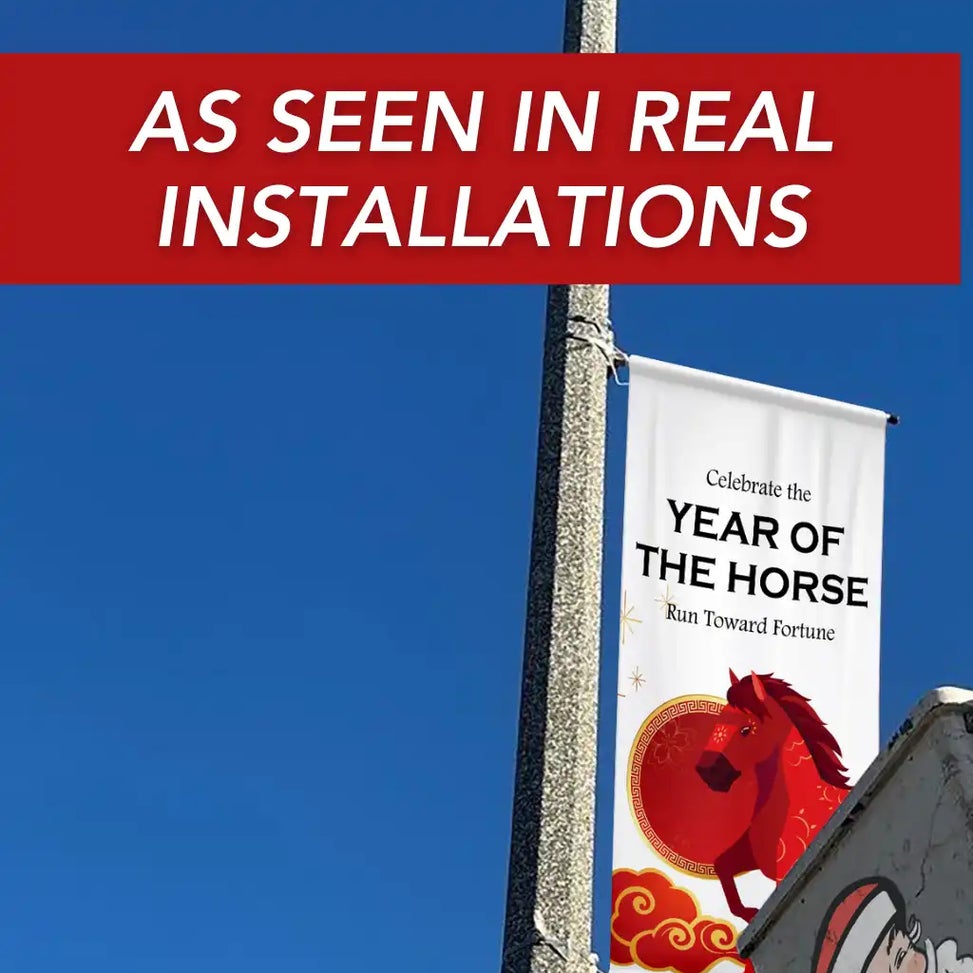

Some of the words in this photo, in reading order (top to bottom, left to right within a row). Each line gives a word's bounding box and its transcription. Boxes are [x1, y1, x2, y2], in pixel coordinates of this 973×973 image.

[706, 469, 782, 498] Celebrate
[787, 482, 812, 502] the
[666, 498, 779, 550] YEAR
[790, 521, 845, 556] OF
[635, 541, 716, 590] THE
[727, 561, 869, 608] HORSE
[666, 603, 698, 625] Run
[704, 609, 768, 635] Toward
[772, 619, 836, 641] Fortune
